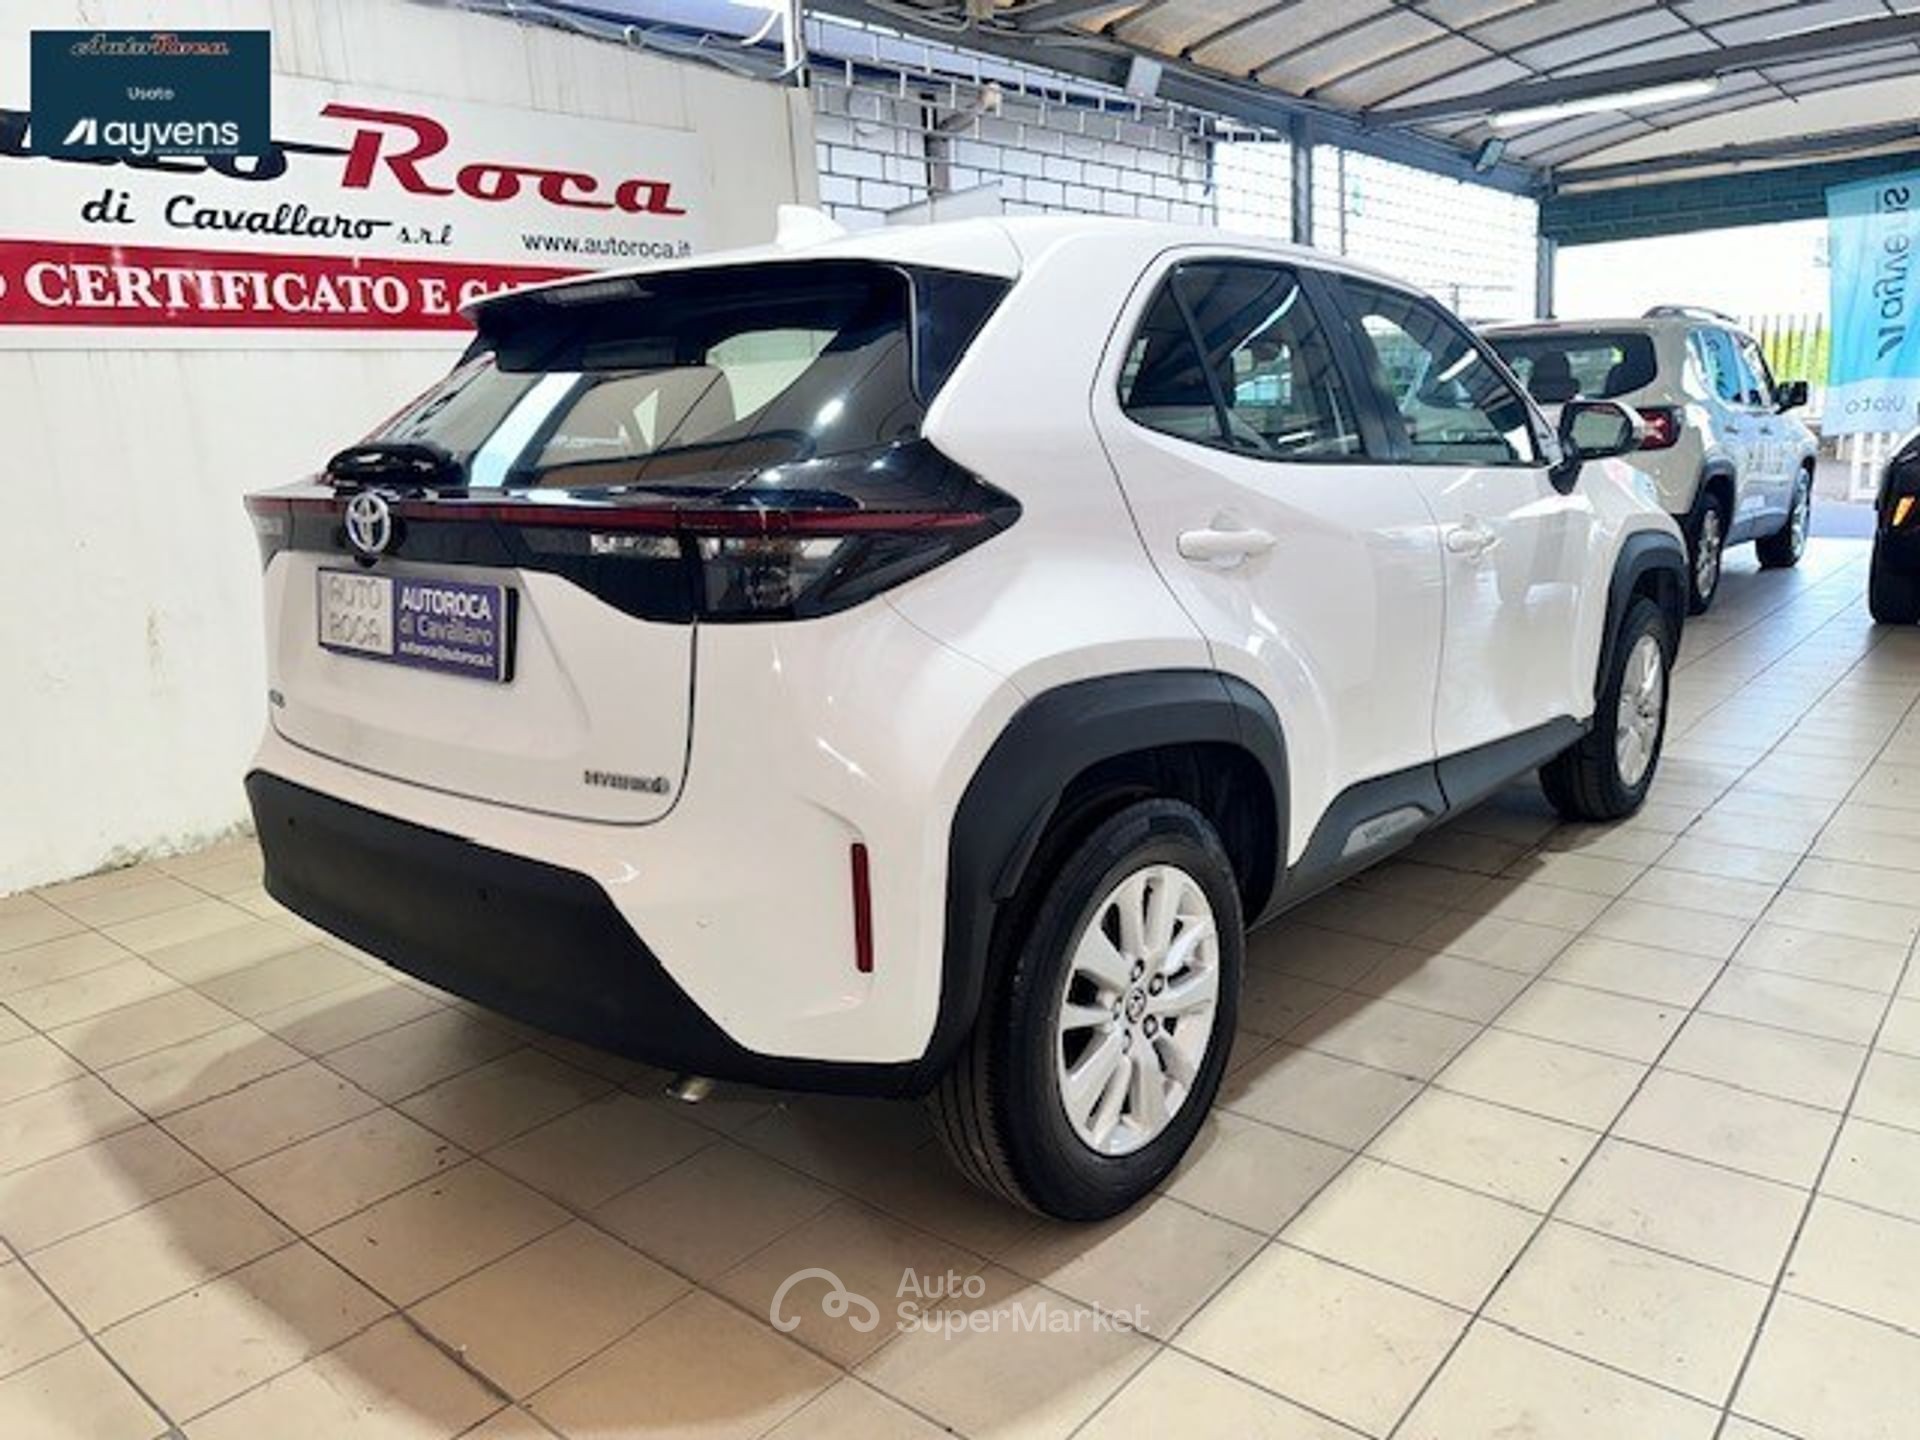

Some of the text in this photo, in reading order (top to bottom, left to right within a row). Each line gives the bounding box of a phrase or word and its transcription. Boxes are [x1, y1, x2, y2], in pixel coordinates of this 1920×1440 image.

[320, 103, 686, 216] Roca
[82, 189, 135, 224] di
[165, 195, 392, 240] Cavallaro
[522, 232, 691, 258] www.autoroca.it
[24, 261, 401, 315] CERTIFICATO
[419, 278, 452, 313] E
[401, 587, 492, 620] AUTOROCA
[417, 614, 493, 646] Cavallaro
